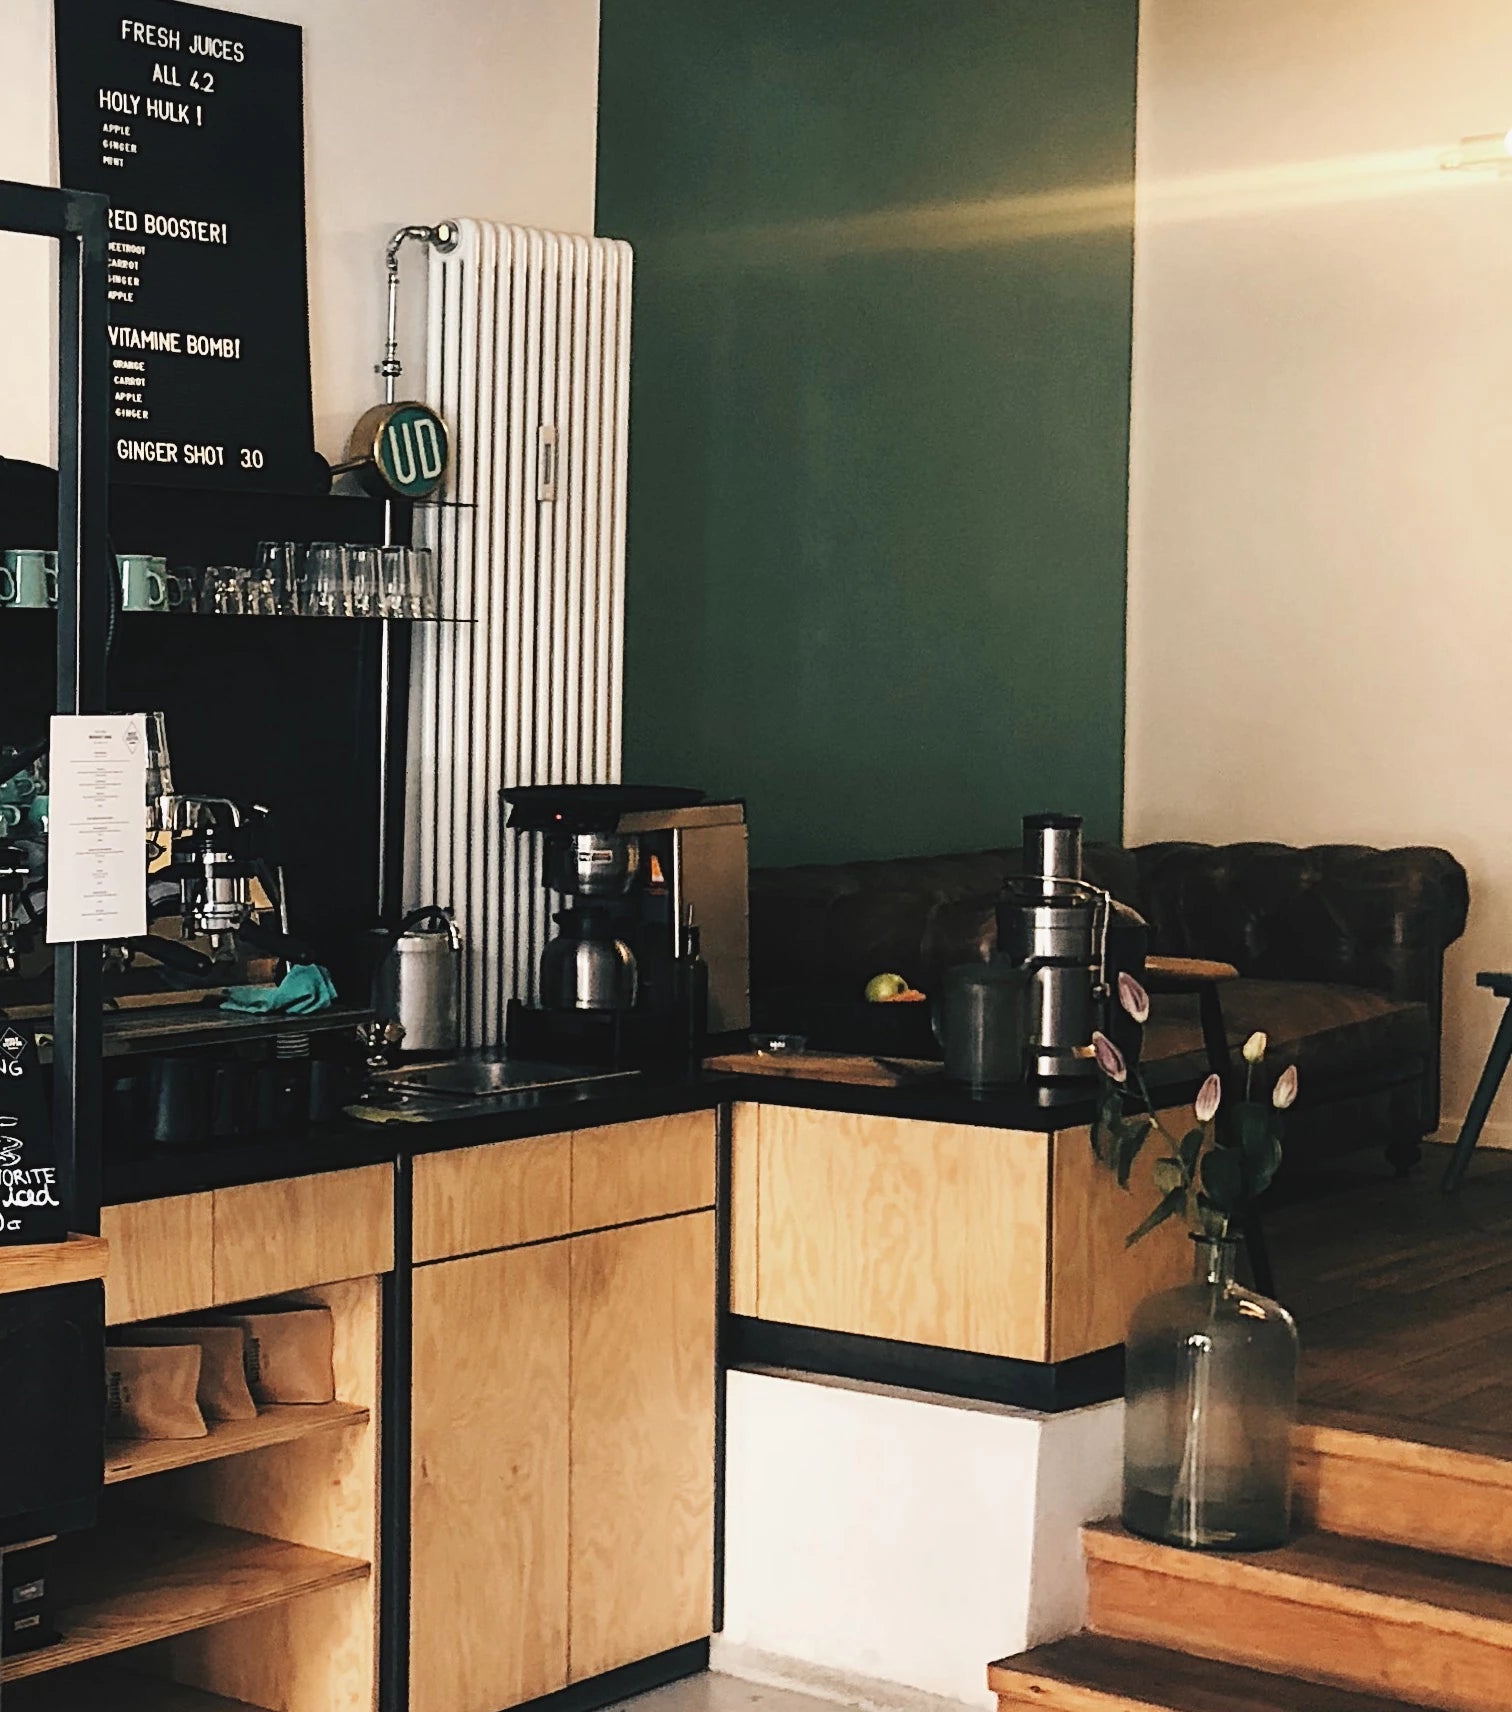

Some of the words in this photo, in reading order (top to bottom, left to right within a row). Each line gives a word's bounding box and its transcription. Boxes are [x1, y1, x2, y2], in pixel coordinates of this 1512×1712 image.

[121, 19, 180, 51] FRESH
[188, 34, 245, 63] JUICES
[152, 63, 182, 87] ALL
[189, 70, 215, 93] 4.2
[99, 88, 141, 115] HOLY
[146, 97, 190, 125] HULK
[102, 123, 131, 137] APPLE
[102, 139, 138, 154] GINGER
[107, 325, 182, 353] VITAMINE
[112, 359, 146, 372] ORANGE
[113, 375, 146, 387] CARROT
[114, 391, 143, 403] APPLE
[114, 407, 149, 420] GINGER
[116, 438, 178, 463] GINGER
[183, 443, 224, 466] SHOT
